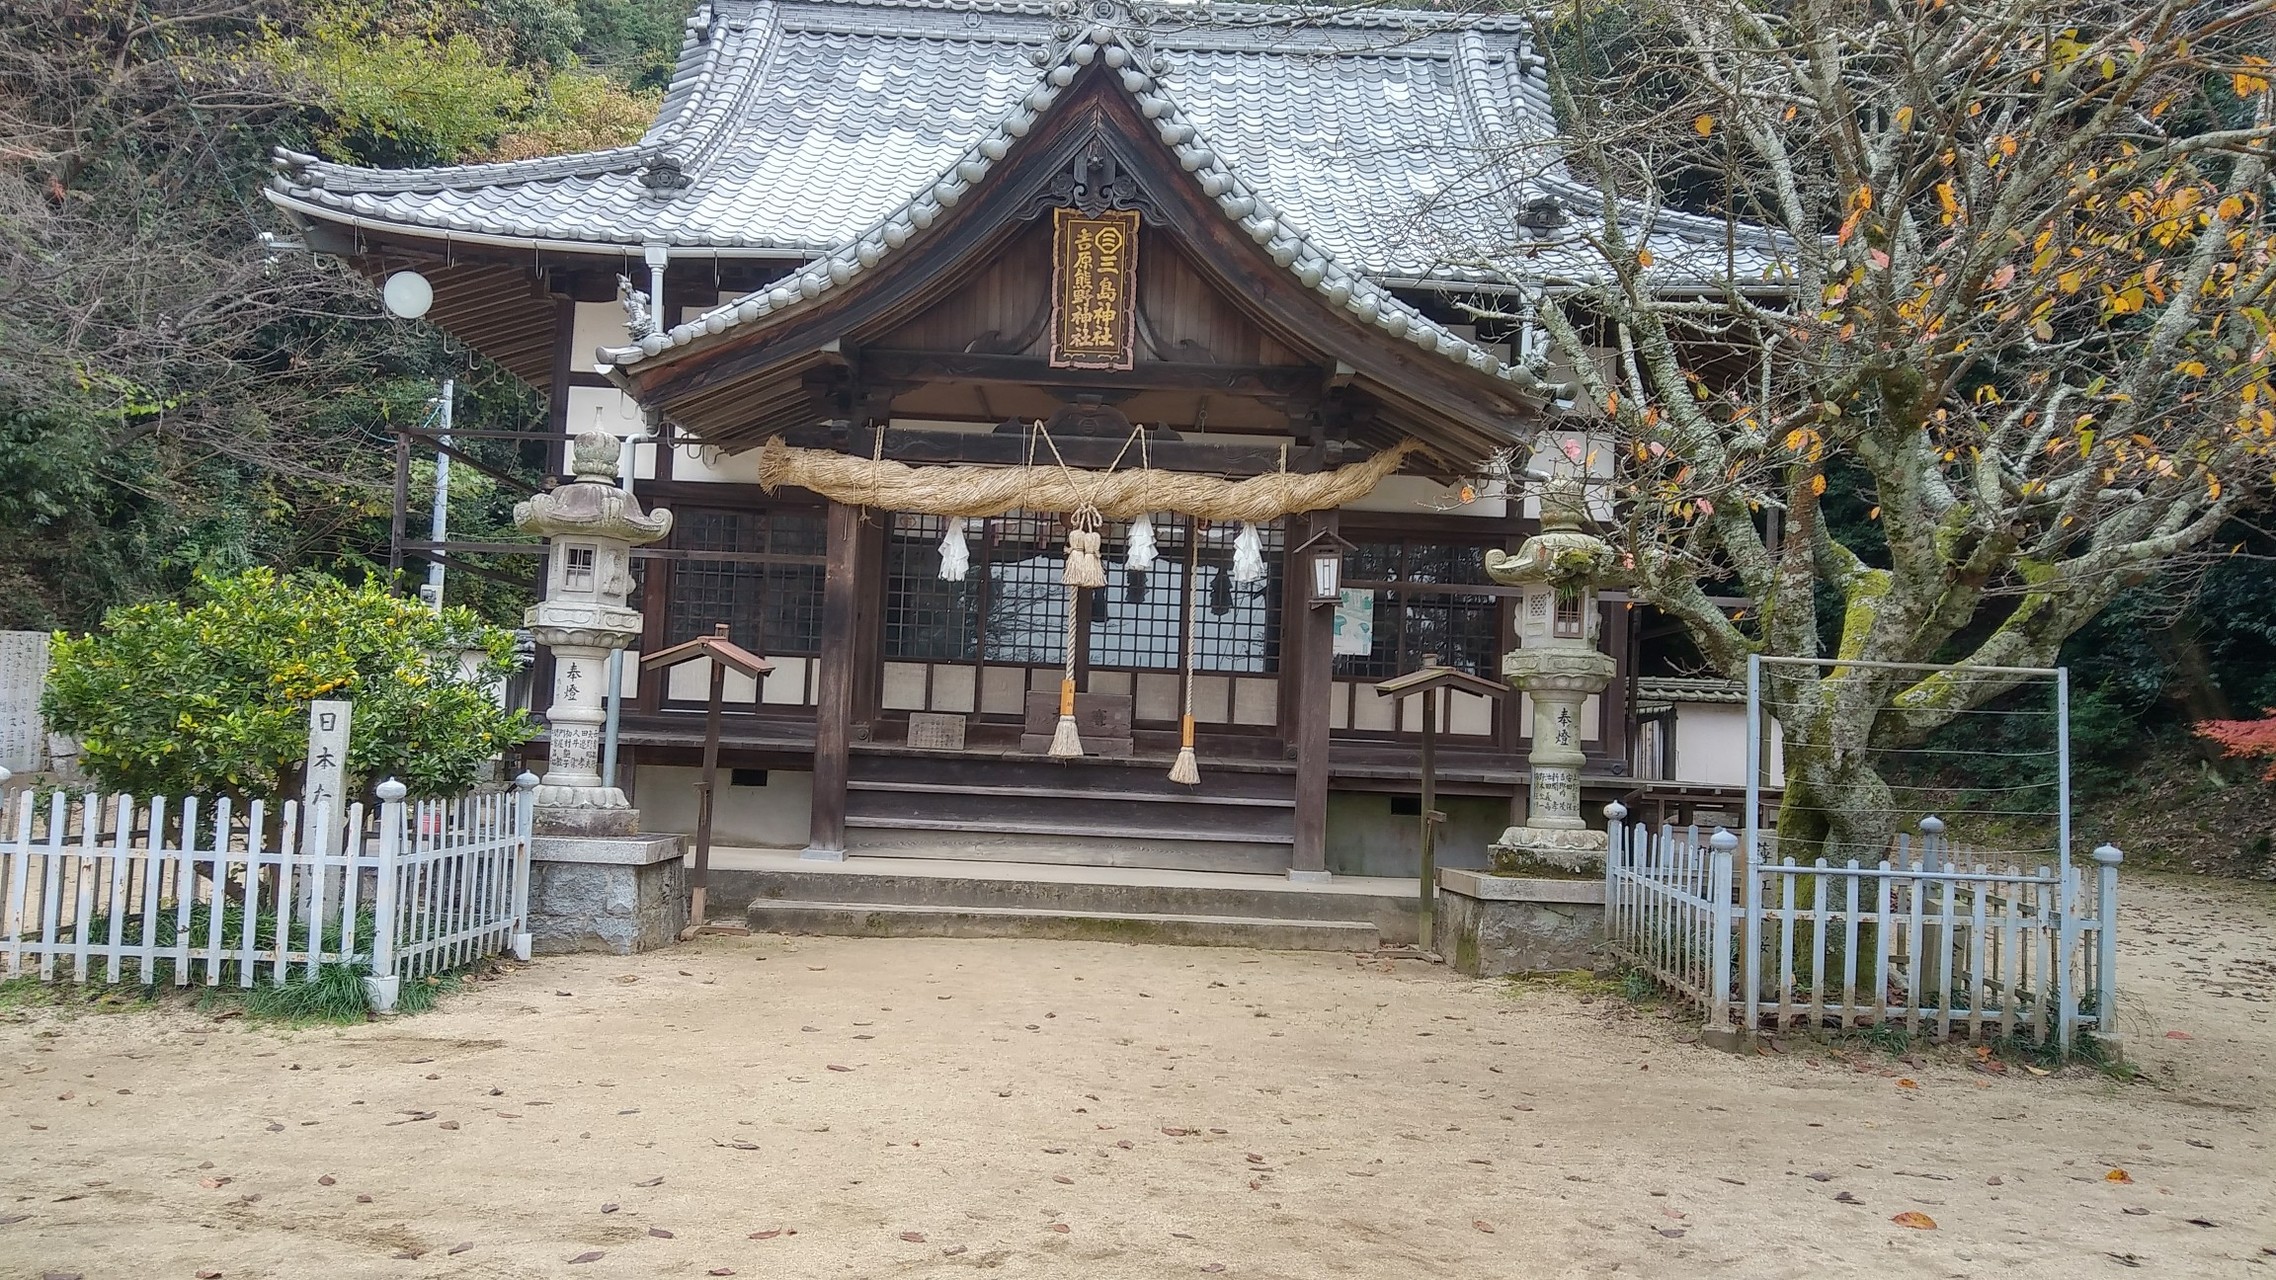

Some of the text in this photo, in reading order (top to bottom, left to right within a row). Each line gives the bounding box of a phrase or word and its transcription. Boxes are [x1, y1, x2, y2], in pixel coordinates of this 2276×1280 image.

[1069, 227, 1095, 348] 吉原熊野神社
[1092, 255, 1119, 347] 三島神社
